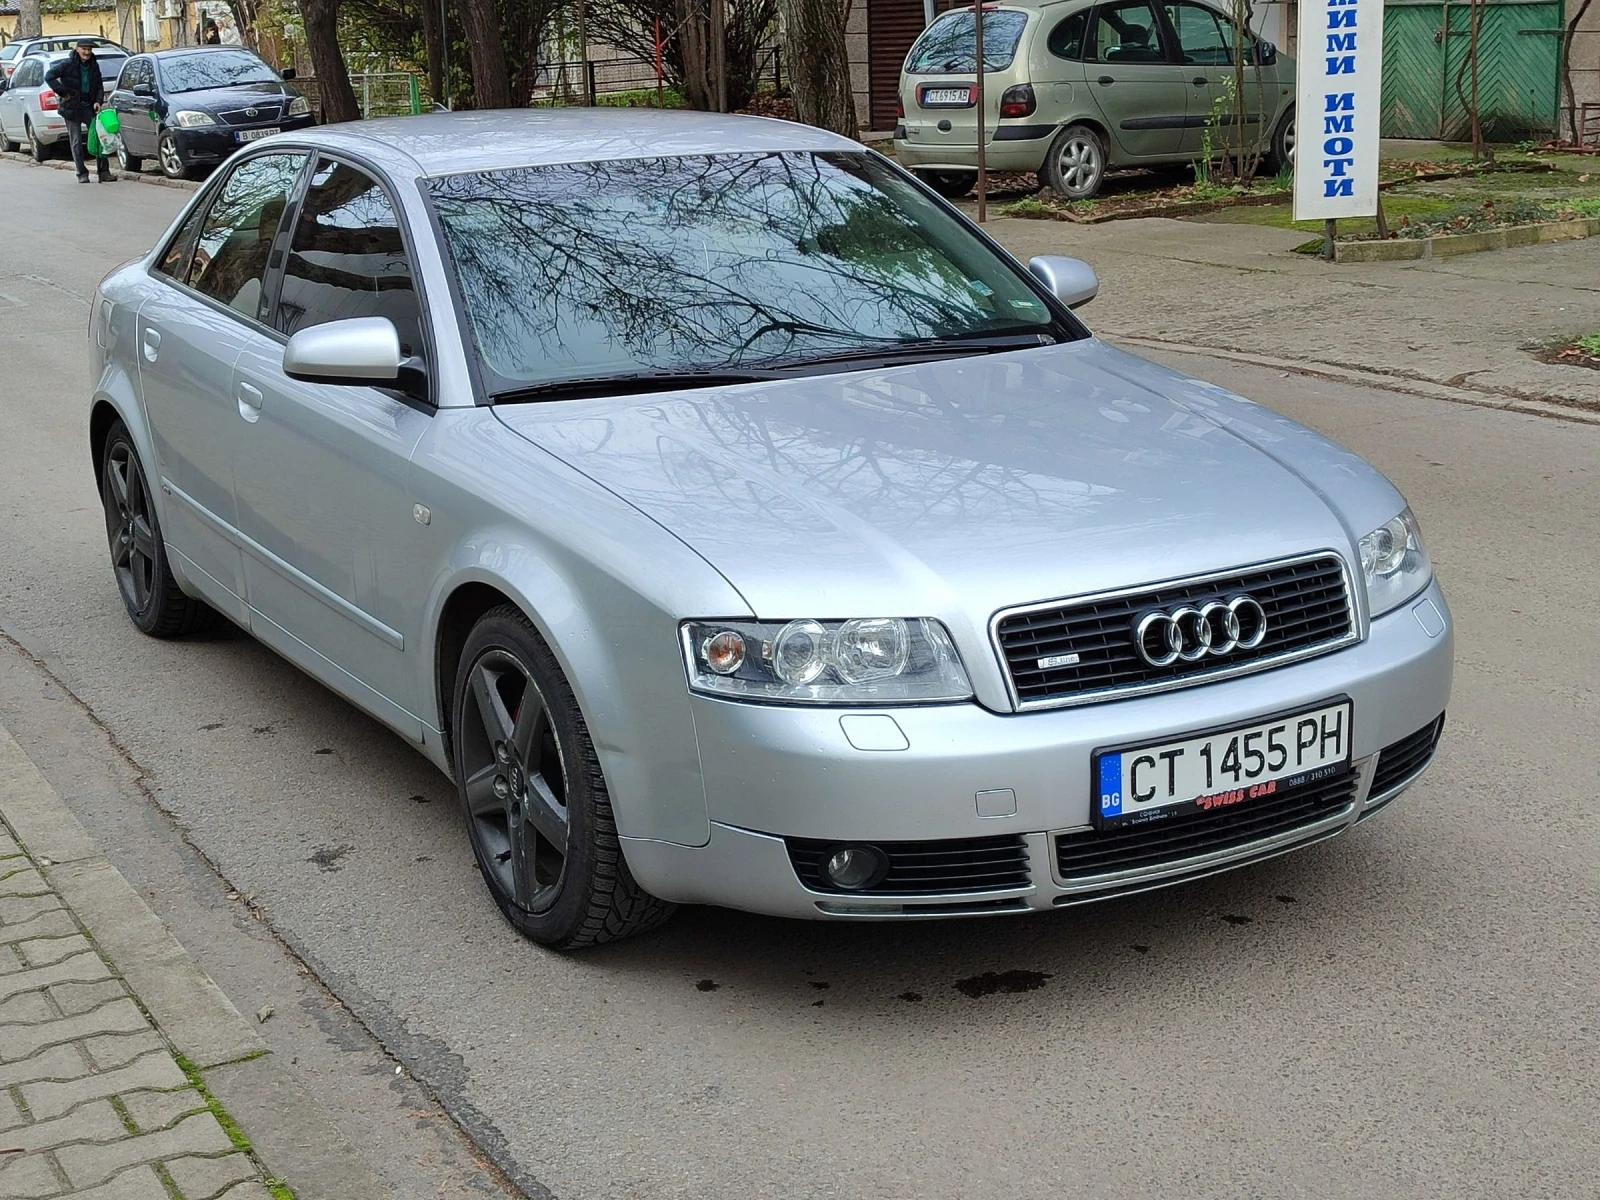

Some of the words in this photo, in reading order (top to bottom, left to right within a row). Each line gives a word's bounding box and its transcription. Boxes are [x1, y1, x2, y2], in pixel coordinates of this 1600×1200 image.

[1323, 92, 1355, 198] ИМОТИ
[1101, 792, 1121, 809] BG
[1130, 748, 1185, 803] CT
[1199, 725, 1288, 789] 1455
[1296, 711, 1343, 766] PH
[1249, 780, 1277, 798] CAR
